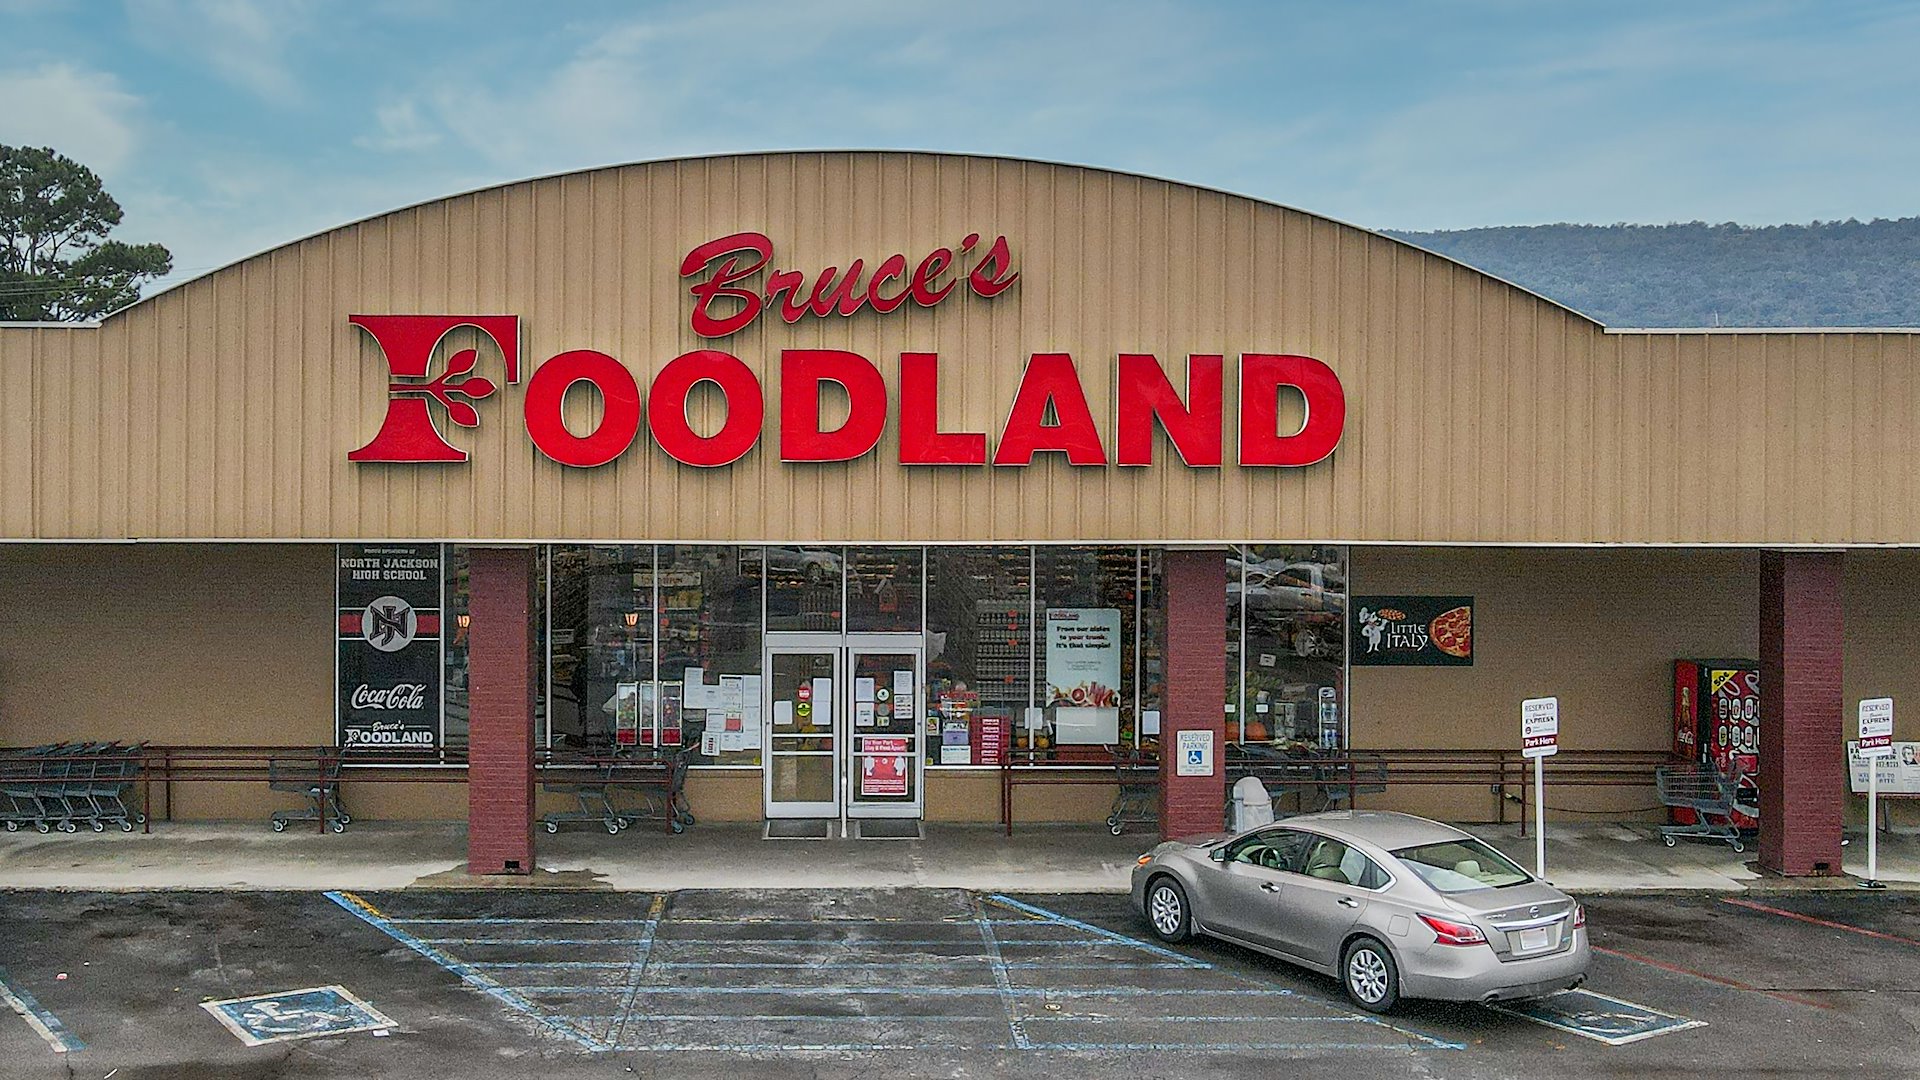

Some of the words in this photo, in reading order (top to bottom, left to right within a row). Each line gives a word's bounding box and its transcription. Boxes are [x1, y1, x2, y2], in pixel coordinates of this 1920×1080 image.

[680, 231, 1019, 339] Bruce's
[348, 314, 1346, 468] FOODLAND
[341, 558, 380, 568] NORTH
[383, 558, 439, 568] JACKSON
[352, 570, 380, 580] HIGH
[383, 570, 427, 580] SCHOOL
[351, 684, 428, 710] Coca-Cola
[372, 720, 405, 732] Bruce's
[344, 729, 434, 743] FOODLAND
[1525, 738, 1539, 747] Park
[1540, 737, 1555, 745] Here
[1862, 739, 1875, 747] Park
